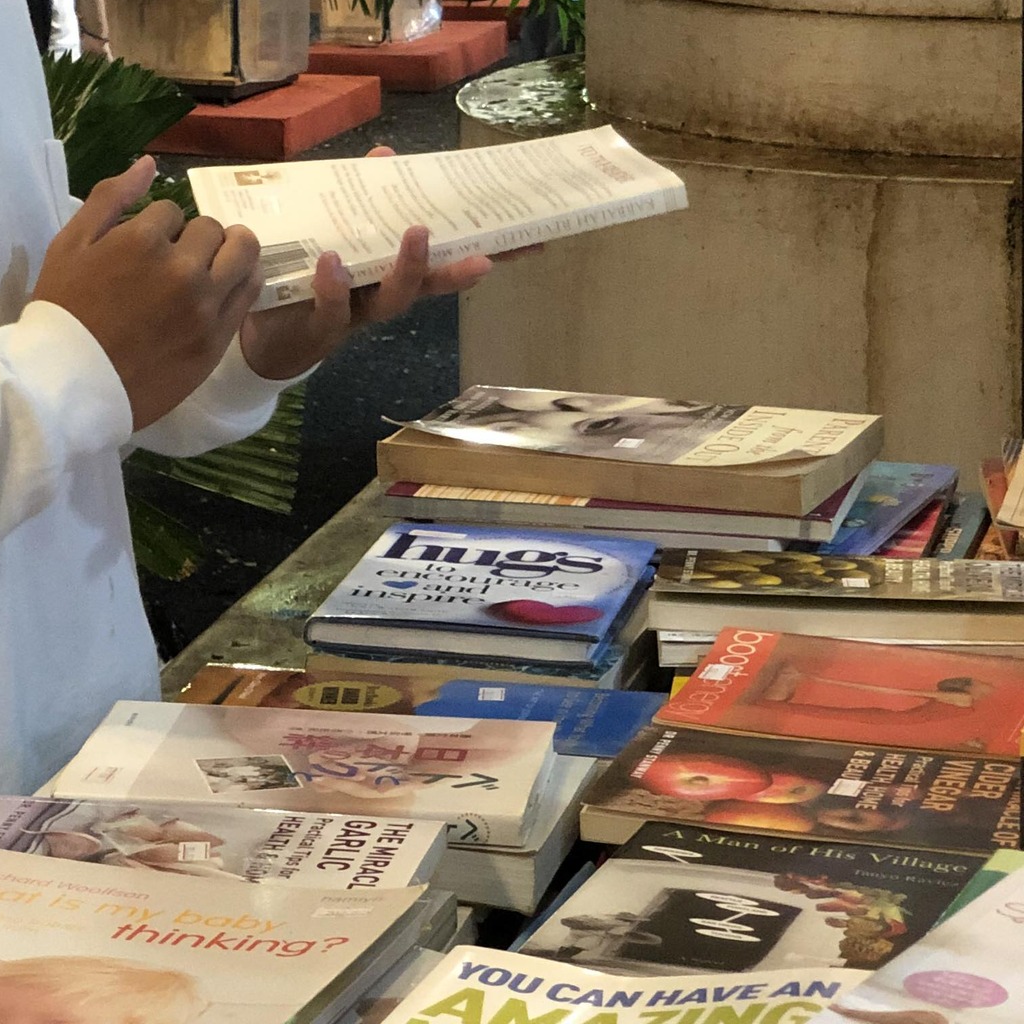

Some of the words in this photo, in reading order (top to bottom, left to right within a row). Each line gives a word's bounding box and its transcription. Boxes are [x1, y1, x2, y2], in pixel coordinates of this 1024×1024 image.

[376, 531, 604, 579] hugs
[425, 563, 456, 574] to
[376, 567, 581, 592] encourage
[421, 582, 491, 595] and
[350, 584, 487, 605] inspire
[852, 749, 876, 758] &
[840, 757, 872, 780] BEAU
[904, 755, 934, 784] Practical
[969, 763, 1016, 800] CIDER
[855, 785, 887, 811] HOME
[919, 760, 977, 812] VINEGAR
[261, 815, 306, 852] HEALTH
[296, 817, 334, 852] Practical
[316, 820, 378, 872] GARLIC
[376, 822, 414, 846] THE
[286, 850, 313, 868] Tips
[662, 829, 685, 840] A
[695, 832, 760, 851] Man
[766, 841, 805, 856] of
[810, 844, 857, 862] His
[868, 851, 969, 875] Village
[277, 868, 301, 880] for
[346, 845, 399, 890] MIRACL
[64, 881, 151, 902] Woolfson
[48, 891, 82, 912] is
[95, 902, 156, 925] my
[173, 907, 288, 935] baby
[111, 922, 352, 959] thinking?
[456, 960, 541, 994] YOU
[545, 982, 646, 1008] CAN
[645, 982, 765, 1007] HAVE
[768, 980, 843, 999] AN
